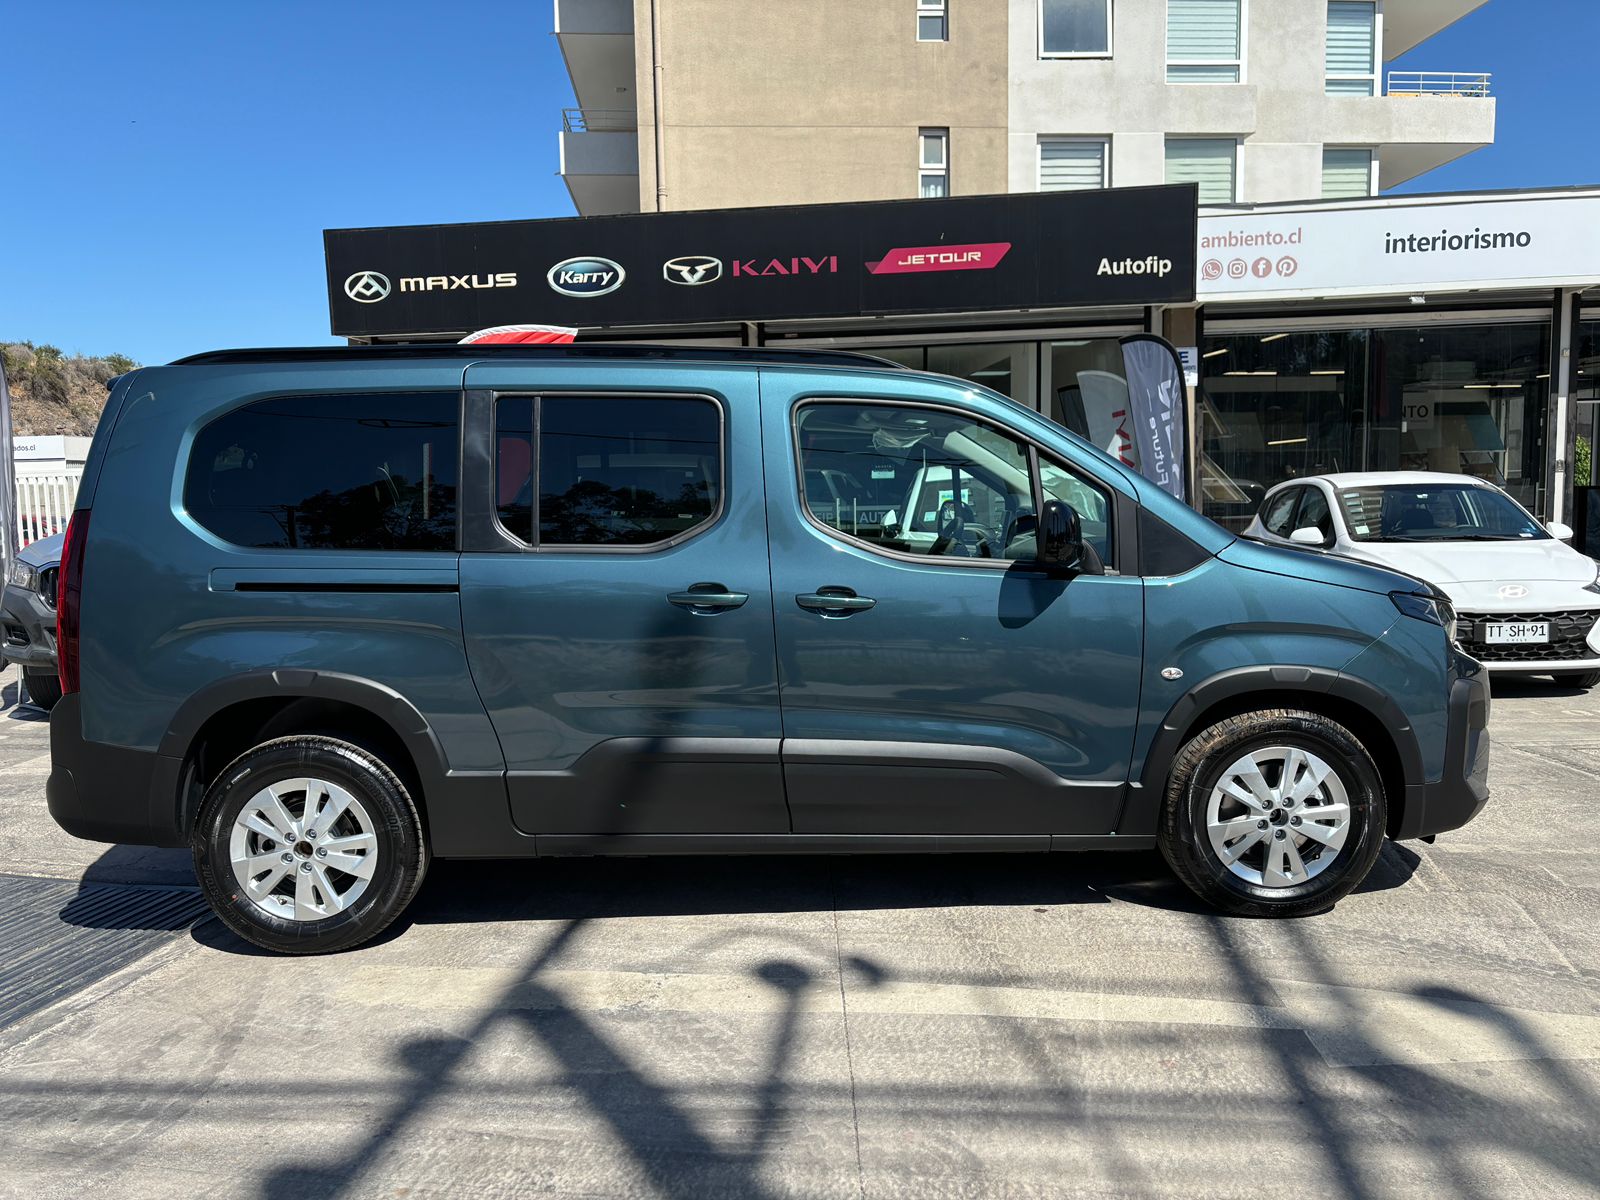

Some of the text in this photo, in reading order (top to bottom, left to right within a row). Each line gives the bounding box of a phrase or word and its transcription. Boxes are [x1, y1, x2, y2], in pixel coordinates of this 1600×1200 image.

[1201, 227, 1302, 249] ambiento.cl
[1385, 227, 1531, 254] interiorismo
[733, 255, 838, 276] KAIYI
[898, 251, 982, 266] JETOUR
[1096, 256, 1173, 278] Autofip
[400, 272, 518, 292] MAXUS
[560, 270, 614, 286] Karry
